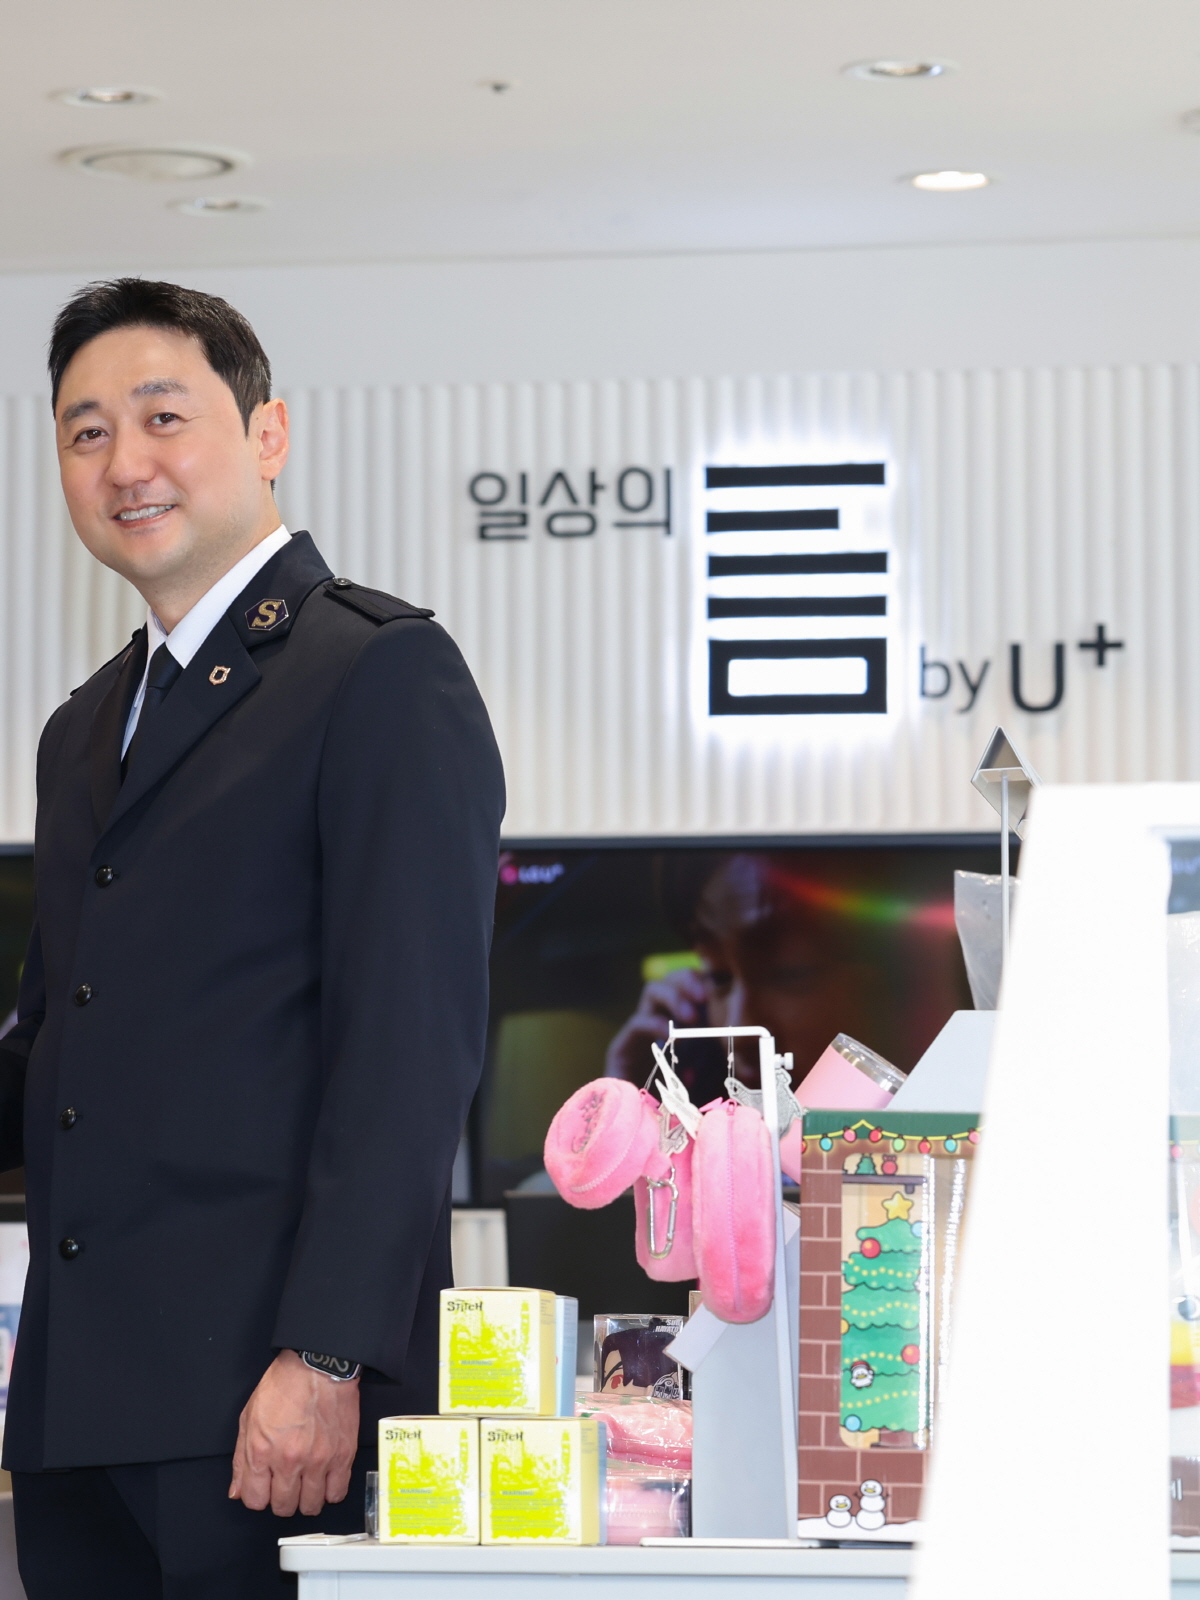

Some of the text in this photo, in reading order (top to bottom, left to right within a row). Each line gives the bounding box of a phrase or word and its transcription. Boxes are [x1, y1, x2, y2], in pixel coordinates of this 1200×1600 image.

[251, 601, 282, 628] S
[468, 465, 673, 541] 일상의
[918, 643, 991, 713] by
[1009, 623, 1125, 713] U+
